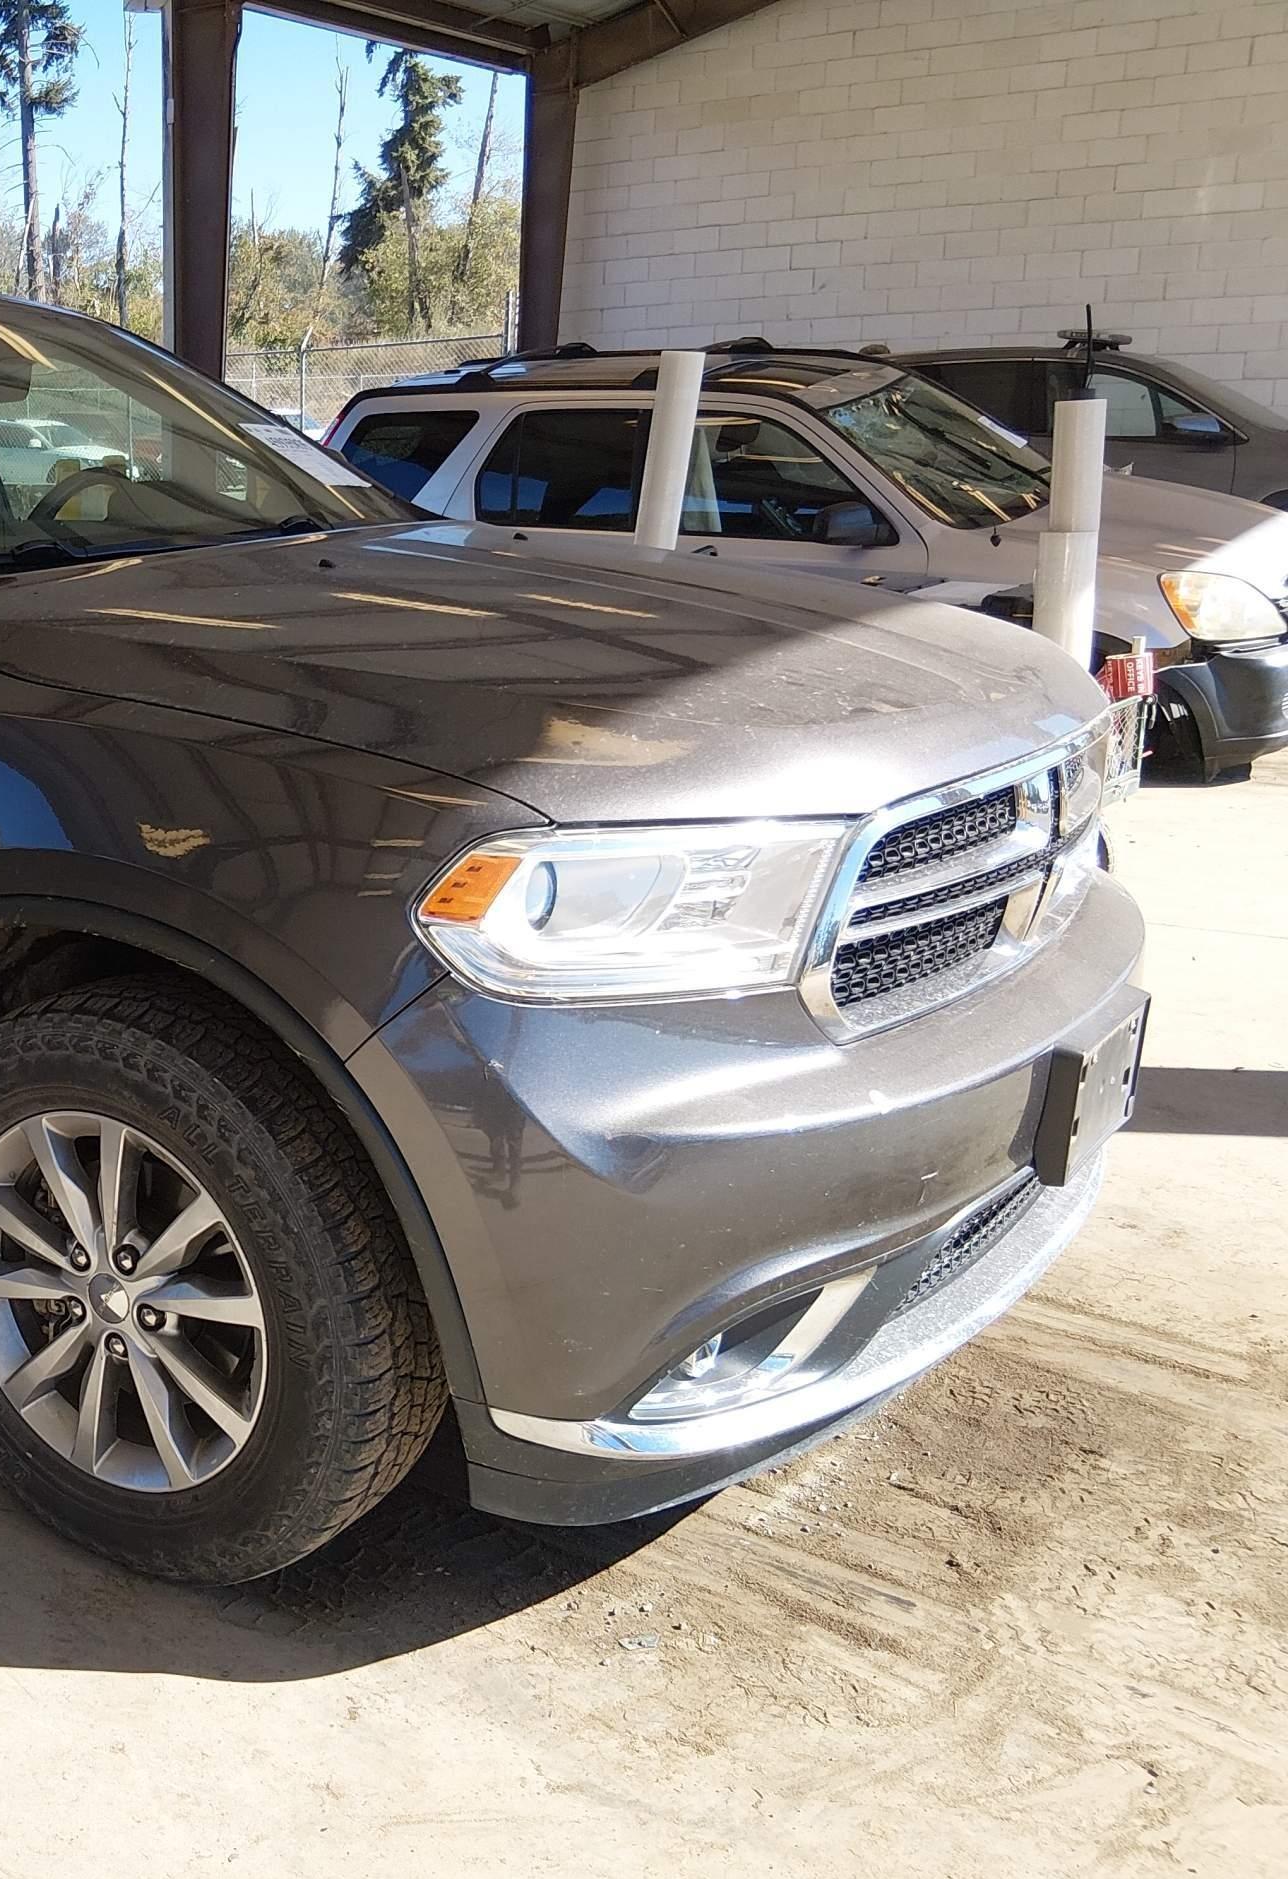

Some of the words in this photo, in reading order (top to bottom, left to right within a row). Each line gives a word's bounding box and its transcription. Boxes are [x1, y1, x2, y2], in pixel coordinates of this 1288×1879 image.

[1126, 661, 1135, 692] OFFICE
[158, 1106, 219, 1167] ALL
[229, 1174, 310, 1369] TERRAIN
